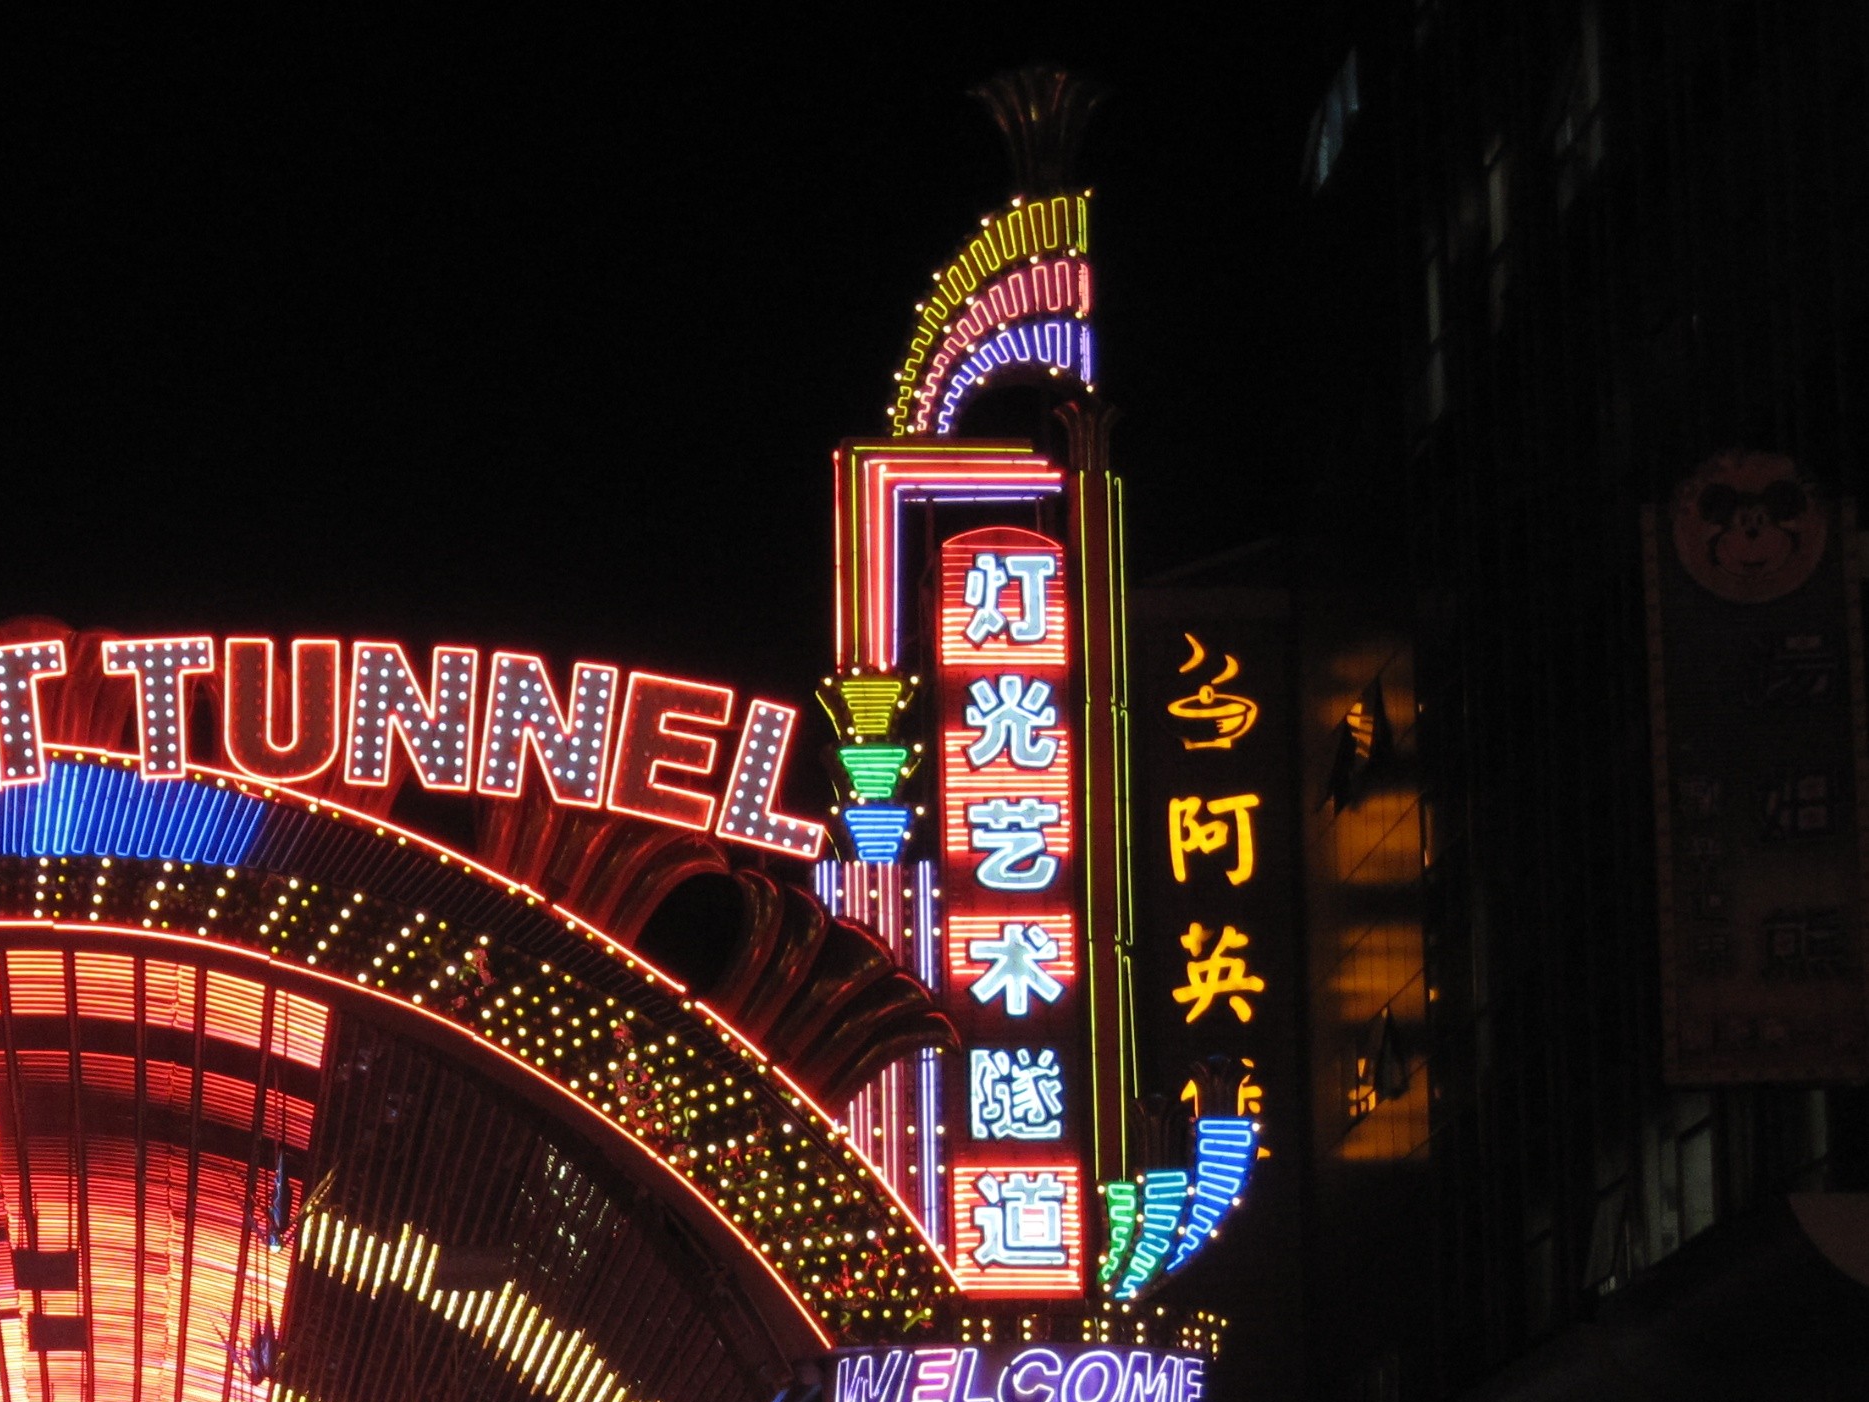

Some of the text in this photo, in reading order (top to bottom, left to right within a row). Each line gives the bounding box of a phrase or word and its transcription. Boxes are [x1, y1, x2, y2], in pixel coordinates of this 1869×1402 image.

[102, 636, 826, 860] TUNNEL
[964, 553, 1068, 1270] 灯光艺术隧道
